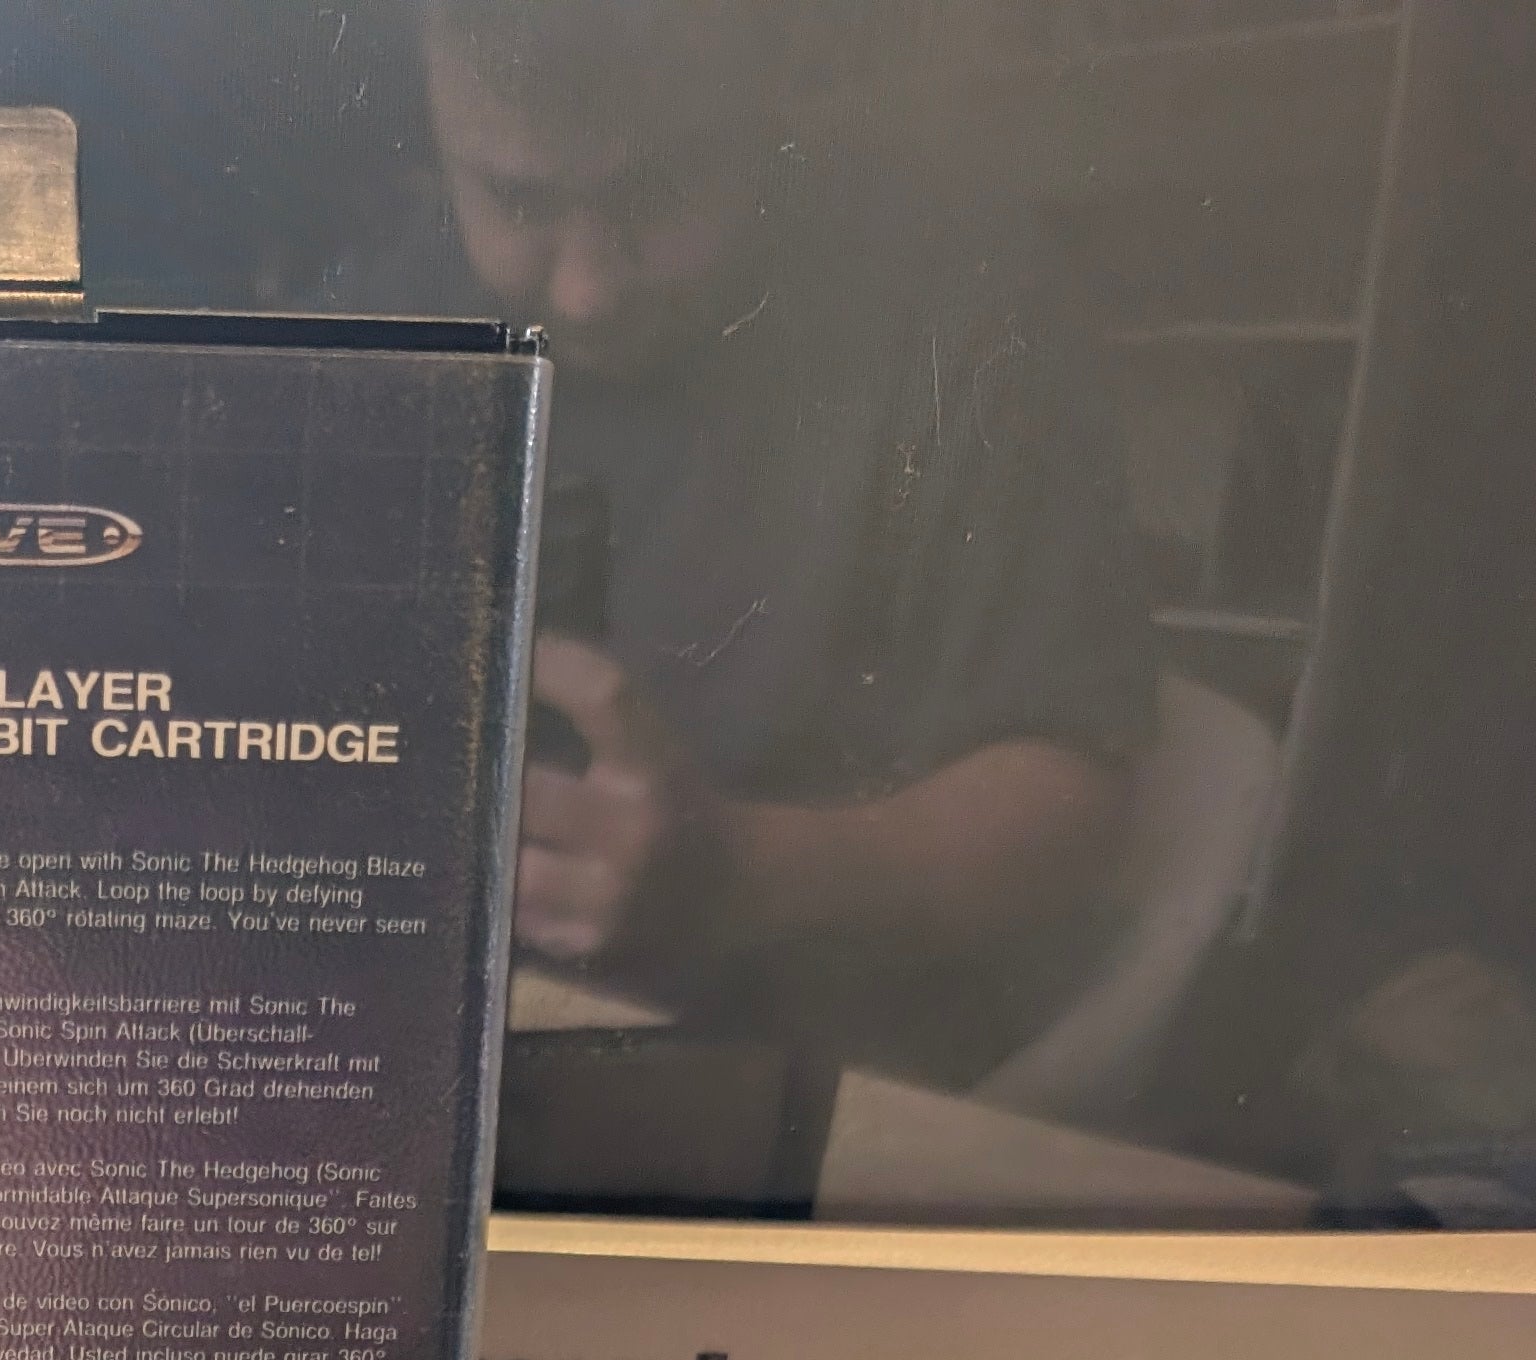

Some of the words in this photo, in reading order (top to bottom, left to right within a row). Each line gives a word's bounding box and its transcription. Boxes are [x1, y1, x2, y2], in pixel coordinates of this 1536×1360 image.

[92, 718, 400, 763] CARTRIDGE
[19, 853, 71, 874] open
[80, 851, 122, 870] with
[132, 850, 190, 872] Sonic
[203, 851, 239, 873] The
[367, 855, 425, 877] Blaze
[98, 879, 149, 904] Loop
[158, 881, 191, 901] the
[200, 881, 244, 906] loop
[253, 882, 278, 907] by
[286, 883, 363, 908] defying
[67, 909, 146, 933] rotating
[228, 910, 299, 932] You've
[309, 916, 367, 933] never
[376, 918, 426, 934] seen
